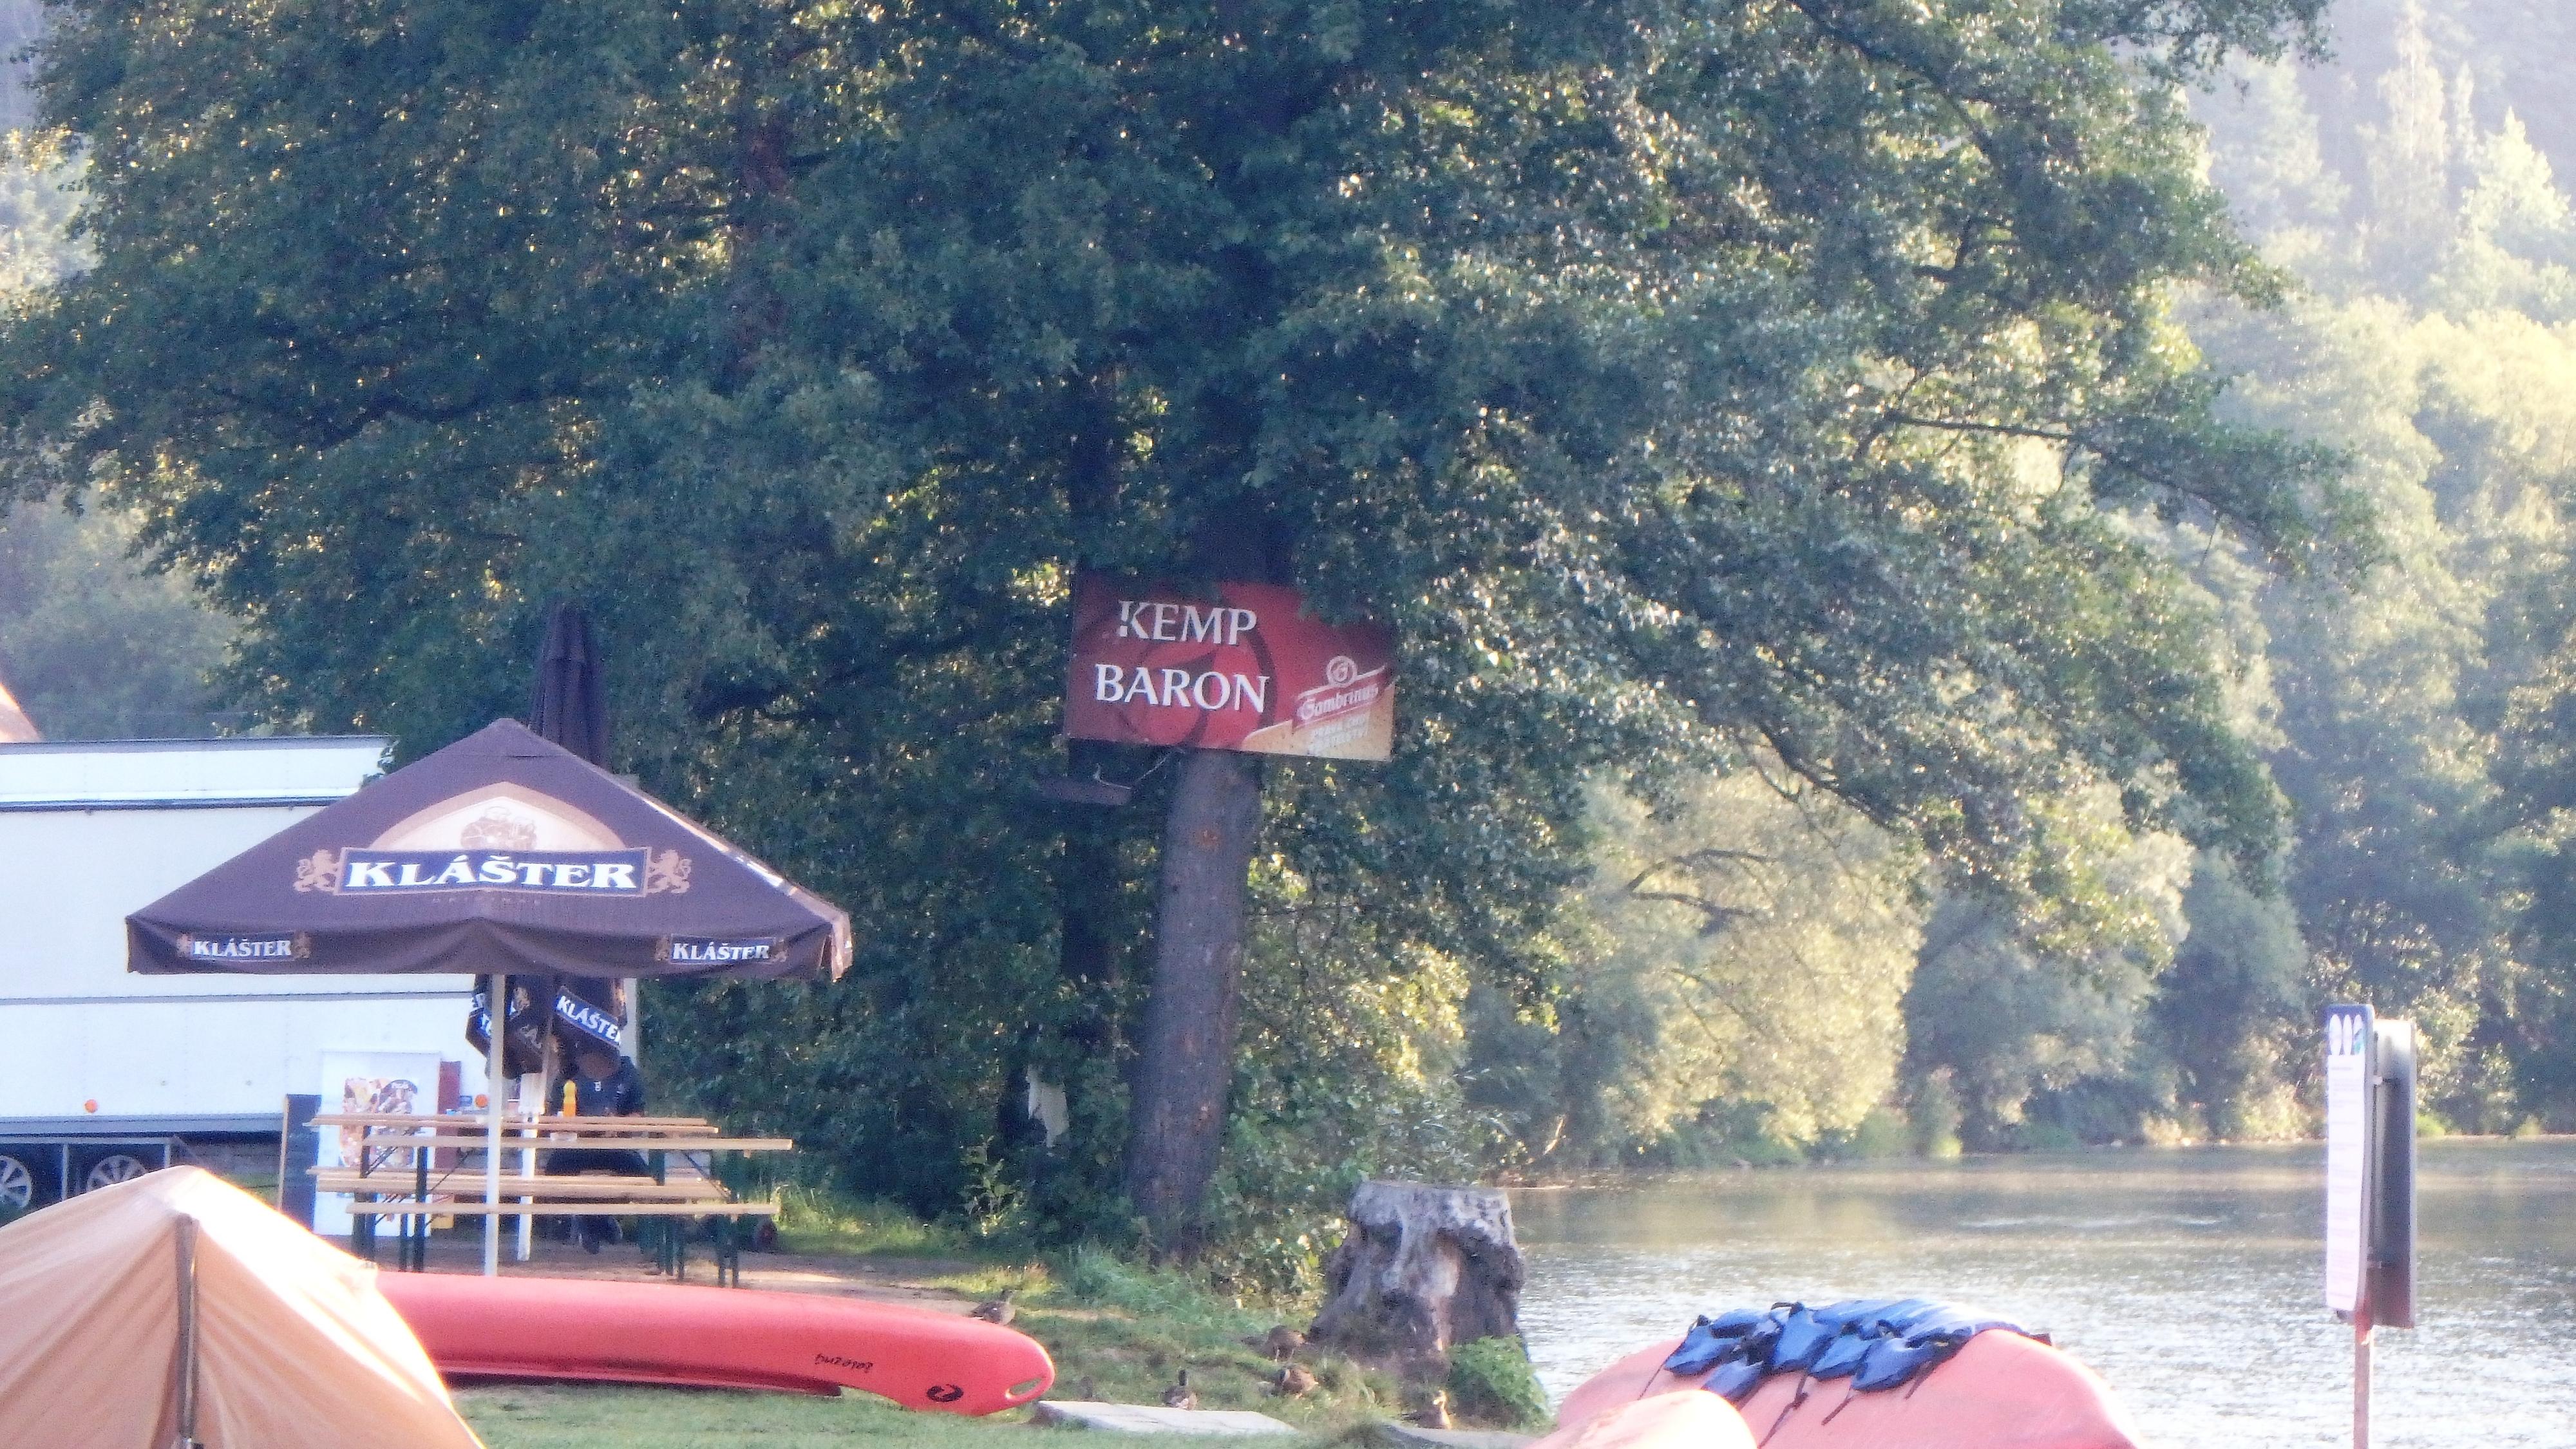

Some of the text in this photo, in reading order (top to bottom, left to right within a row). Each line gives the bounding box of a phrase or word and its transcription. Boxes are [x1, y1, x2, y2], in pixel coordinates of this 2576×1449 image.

[1118, 600, 1257, 645] KEMP
[1095, 663, 1270, 713] BARON
[345, 854, 638, 889] KLÁŠTER
[193, 938, 292, 958] KLÁŠTER
[672, 942, 770, 961] KLÁŠTER
